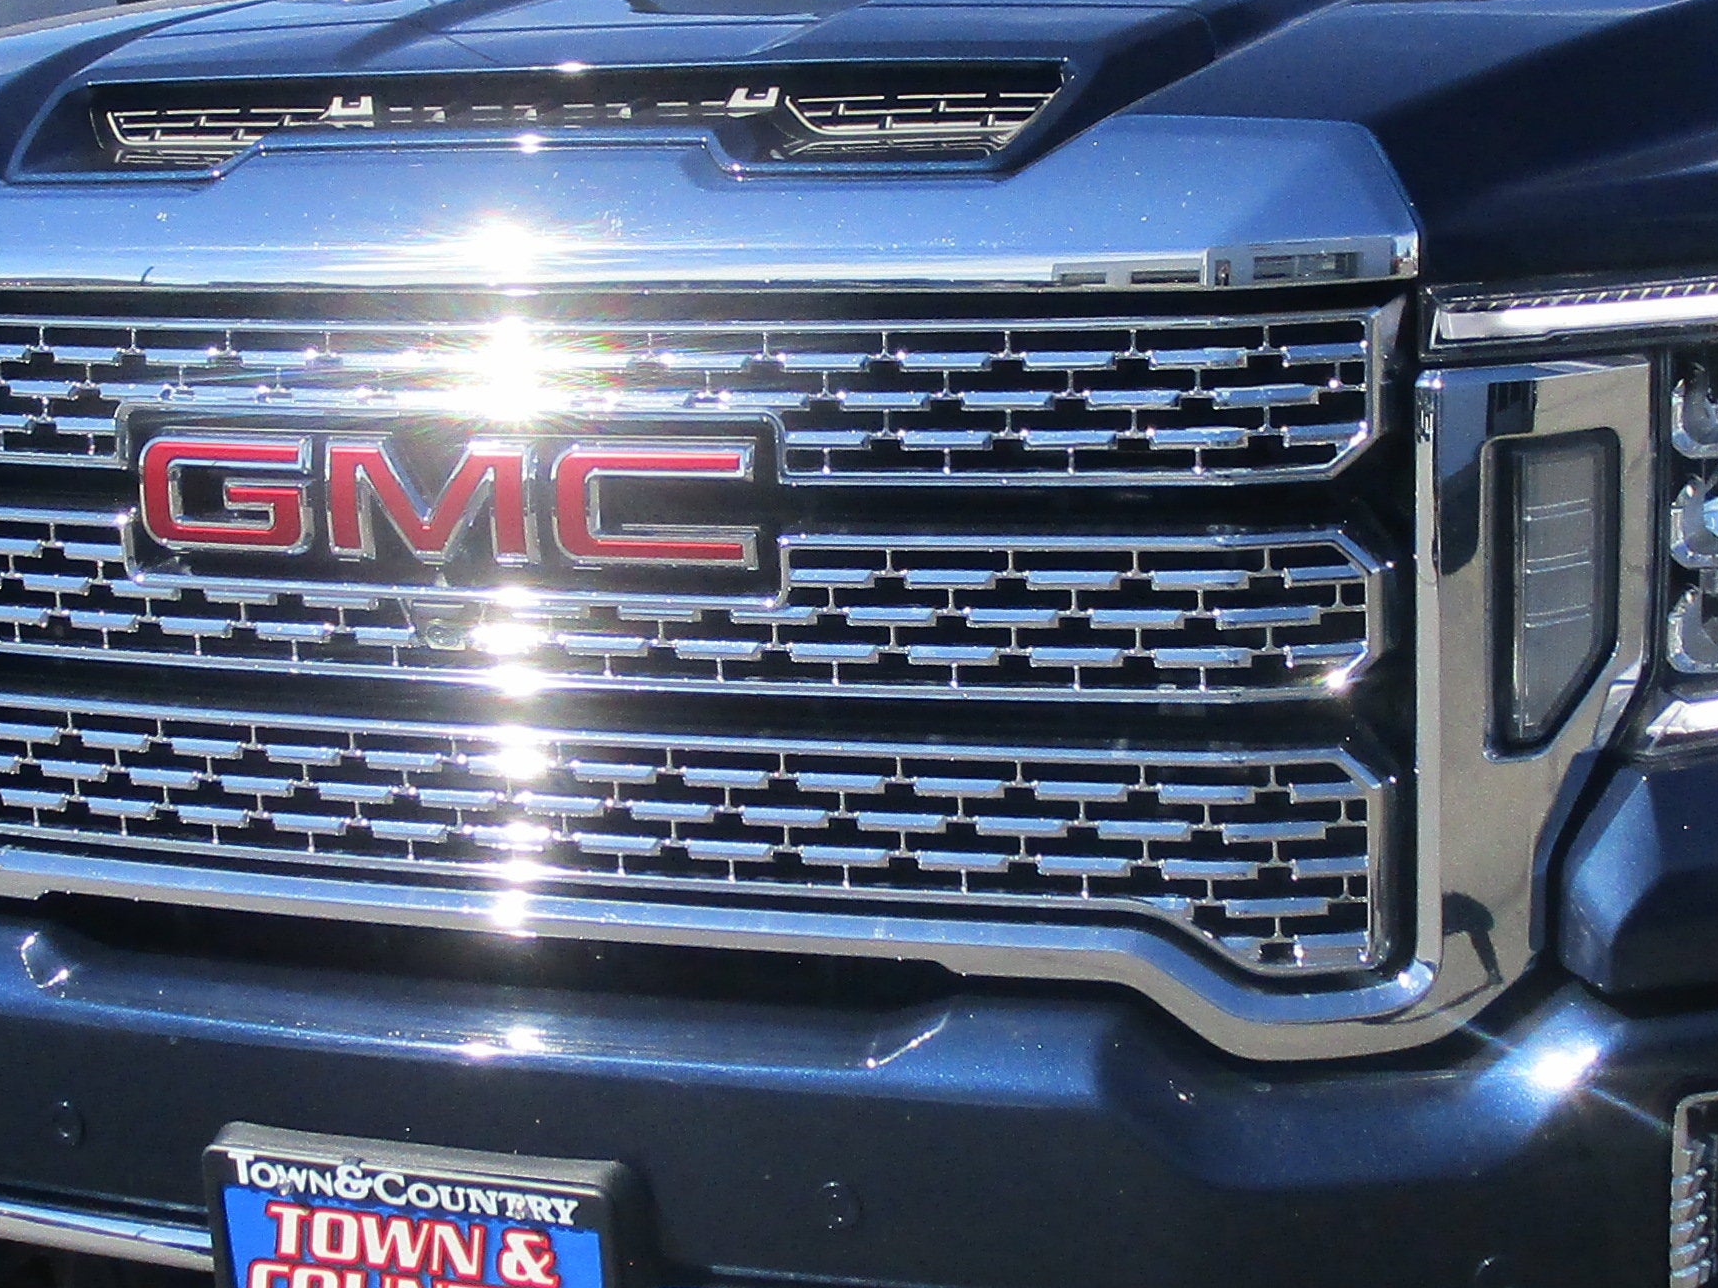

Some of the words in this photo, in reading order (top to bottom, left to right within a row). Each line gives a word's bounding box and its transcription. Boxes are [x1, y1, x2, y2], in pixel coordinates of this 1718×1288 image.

[138, 436, 758, 569] GMC
[268, 1202, 483, 1280] TOWN
[500, 1230, 557, 1288] &
